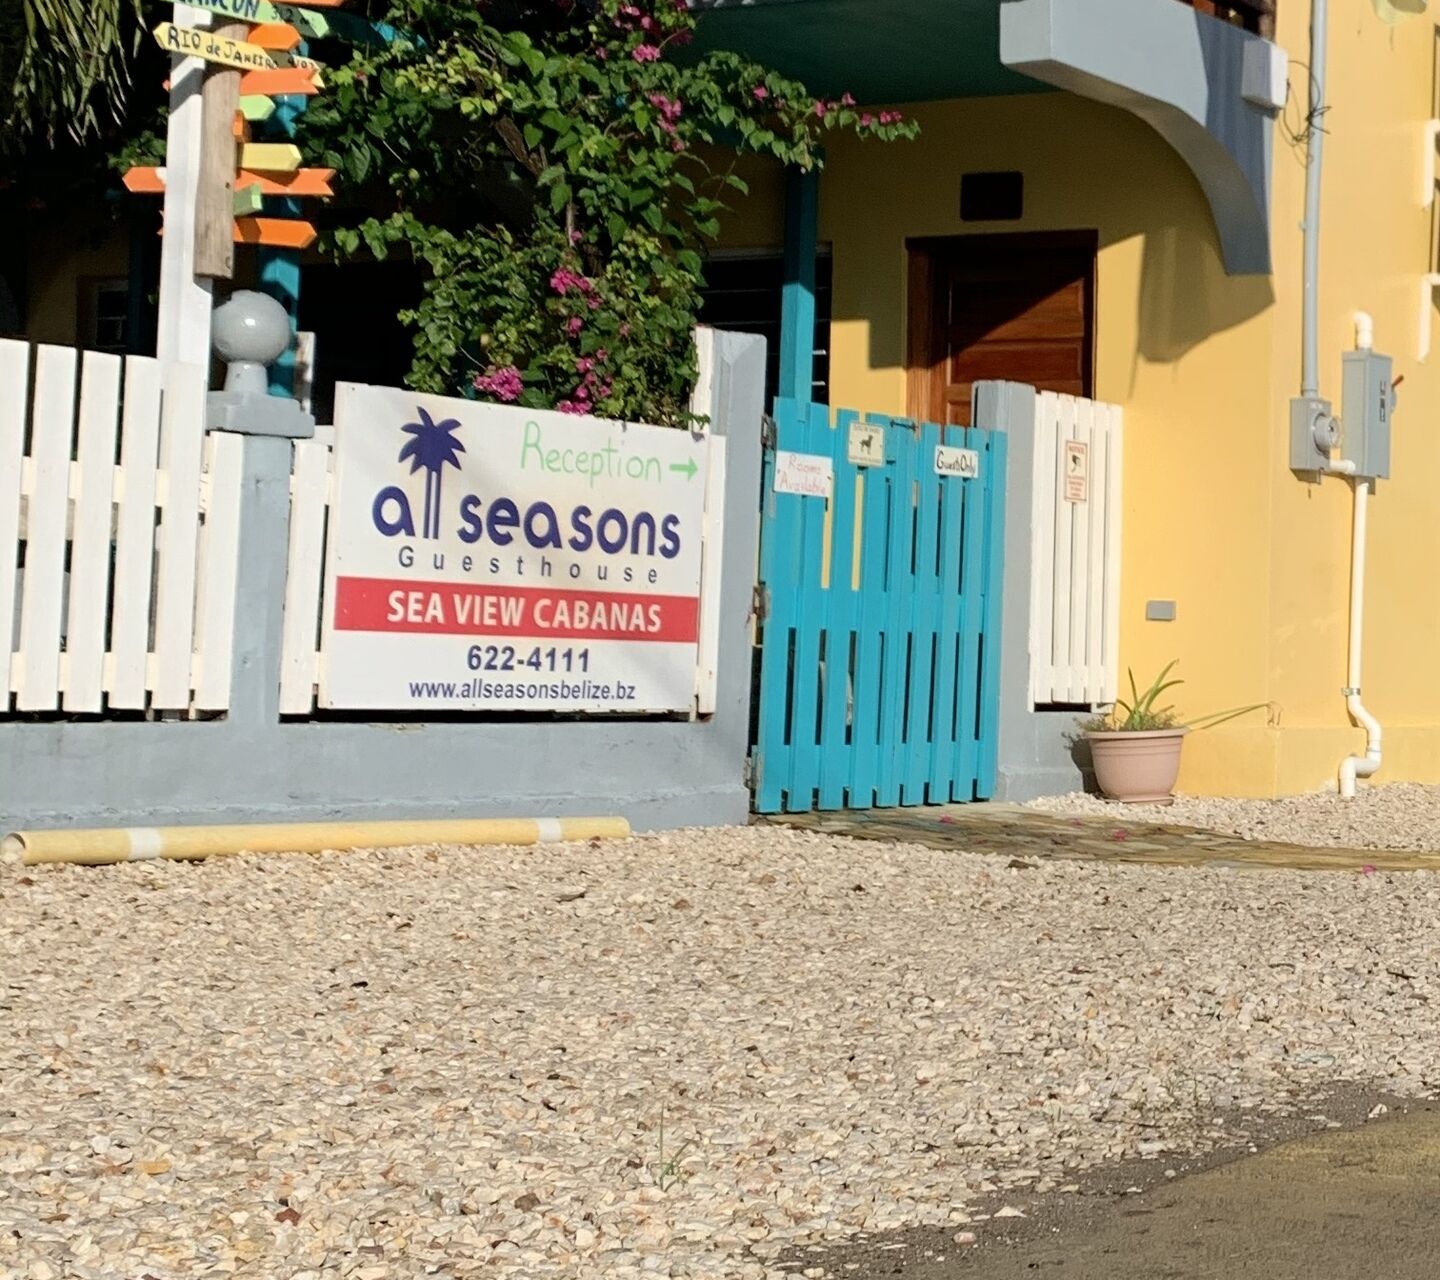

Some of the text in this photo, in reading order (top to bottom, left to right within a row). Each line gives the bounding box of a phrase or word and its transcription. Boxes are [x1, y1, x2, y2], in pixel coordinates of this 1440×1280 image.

[168, 25, 201, 49] RIO
[205, 39, 221, 56] de
[520, 420, 662, 489] Reception
[372, 462, 681, 559] all seasons
[399, 545, 658, 584] Guesthouse
[388, 590, 661, 634] SEA VIEW CABANAS
[467, 645, 590, 673] 622-4111
[410, 678, 635, 700] www.allseasonsbelize.bz
